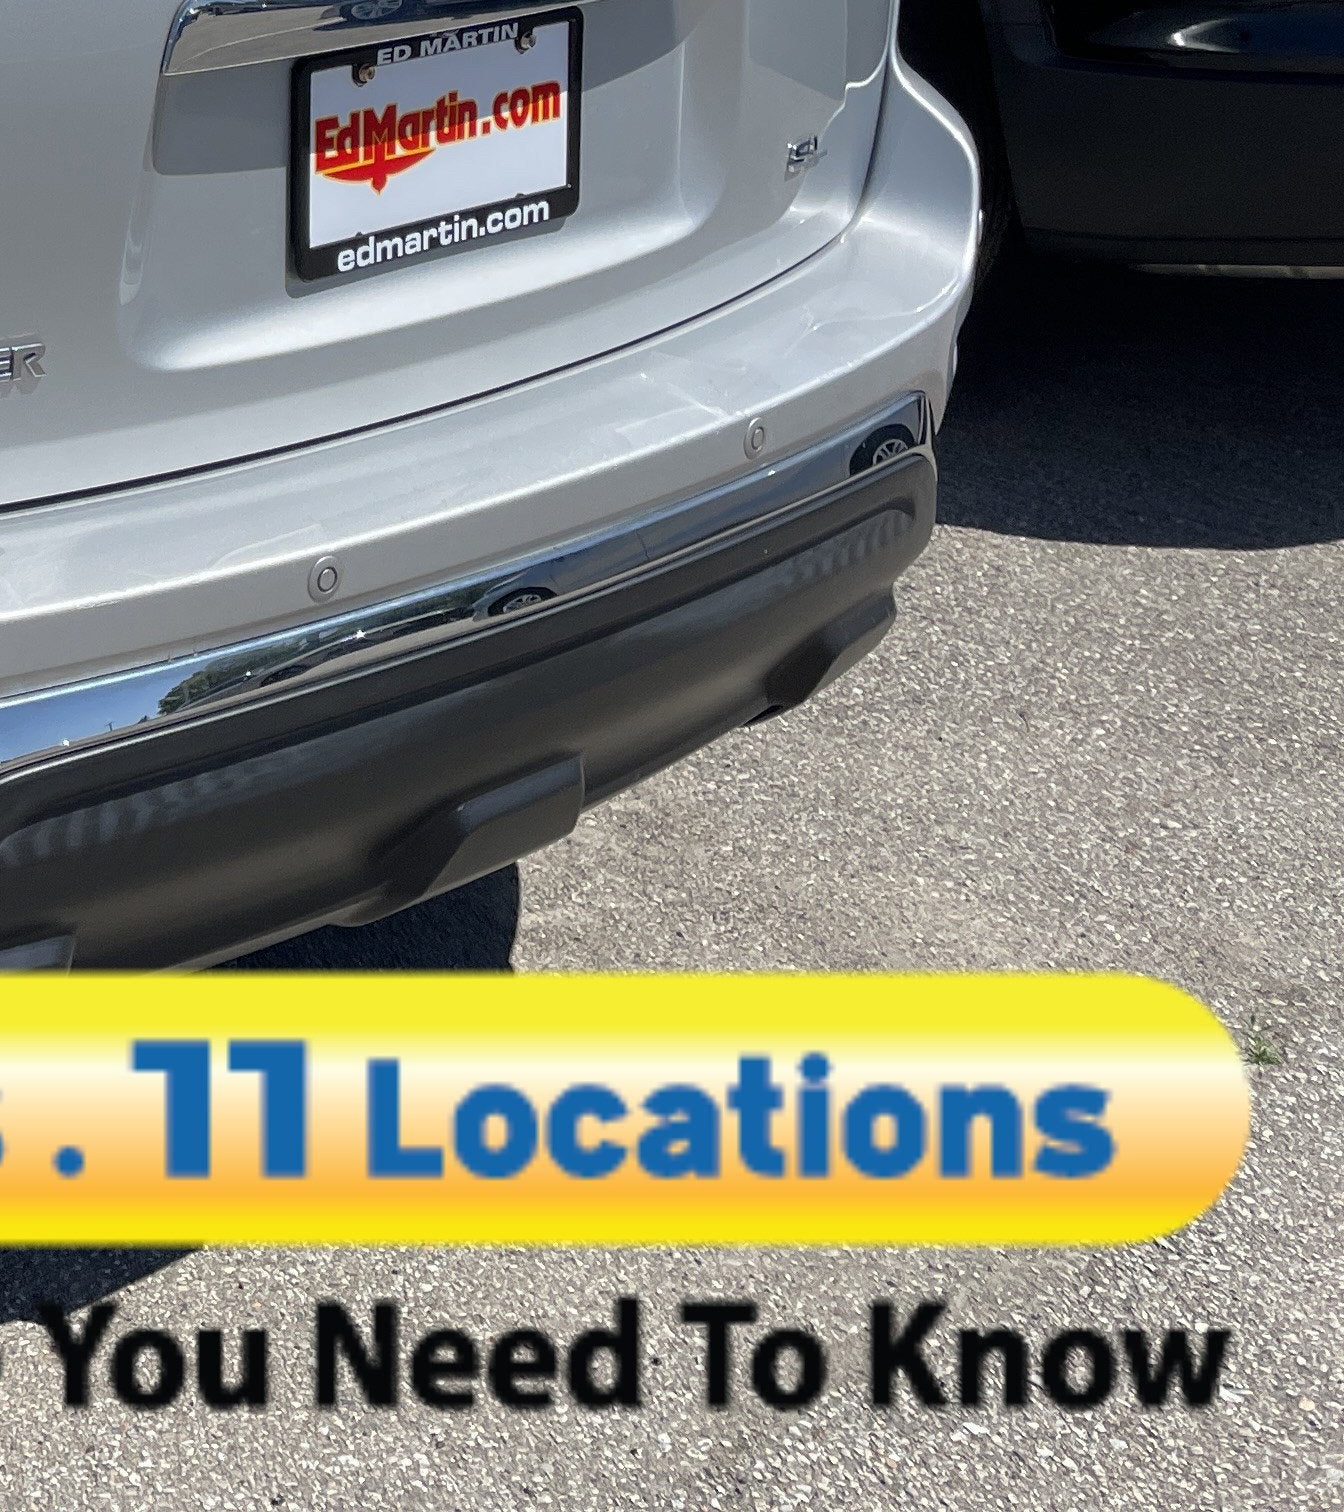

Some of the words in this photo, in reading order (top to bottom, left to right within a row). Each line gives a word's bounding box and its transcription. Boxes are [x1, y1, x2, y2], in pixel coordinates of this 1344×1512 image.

[376, 43, 412, 66] ED
[419, 22, 521, 57] MARTIN
[313, 80, 563, 172] EdMartin.com
[336, 199, 551, 273] edmartin.com
